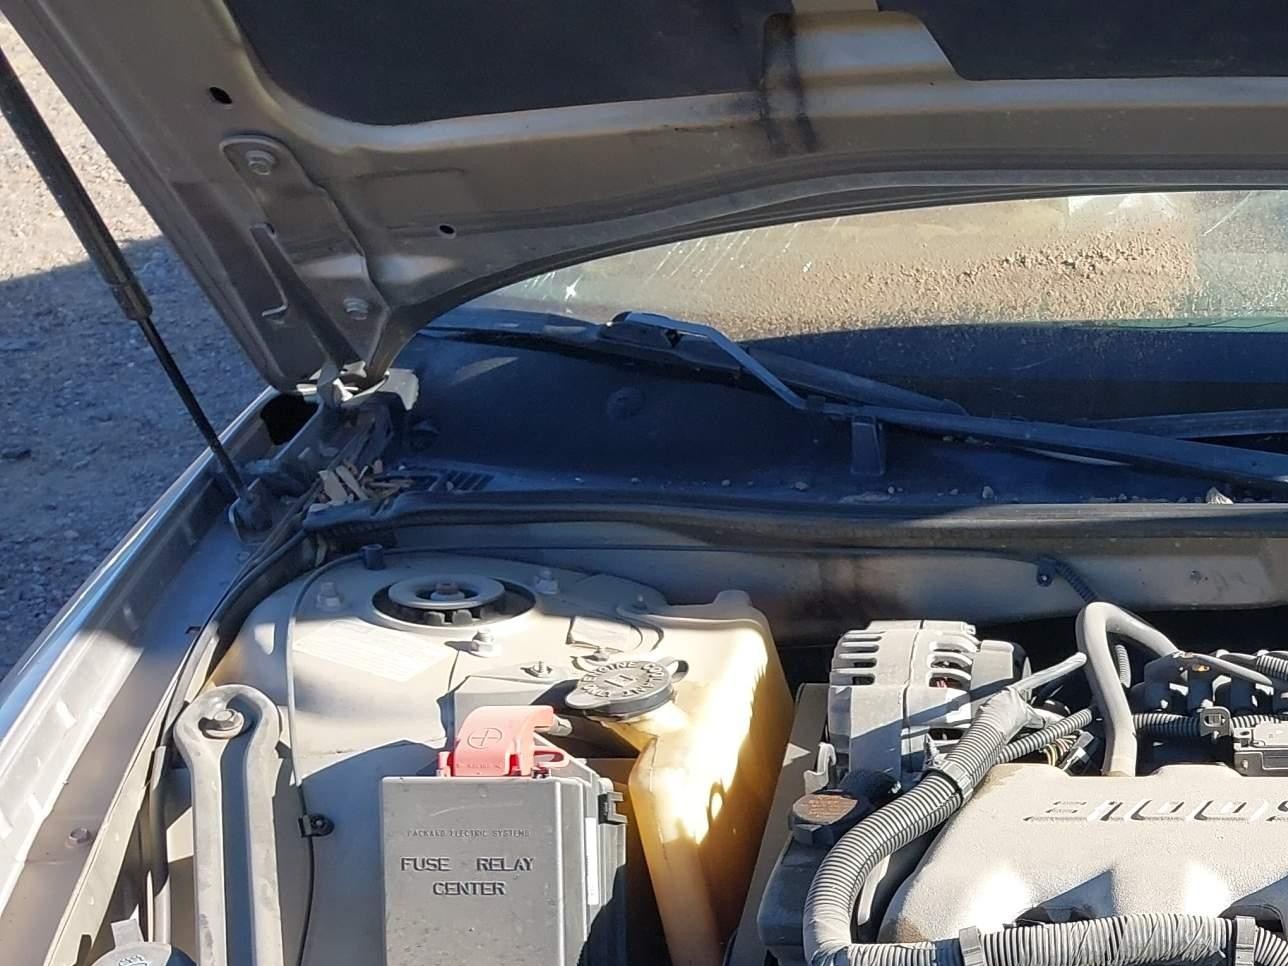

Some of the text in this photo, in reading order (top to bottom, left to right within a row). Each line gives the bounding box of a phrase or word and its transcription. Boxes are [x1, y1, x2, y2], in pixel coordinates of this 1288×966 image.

[400, 857, 535, 872] FUSE RELAY
[432, 881, 506, 896] CENTER
